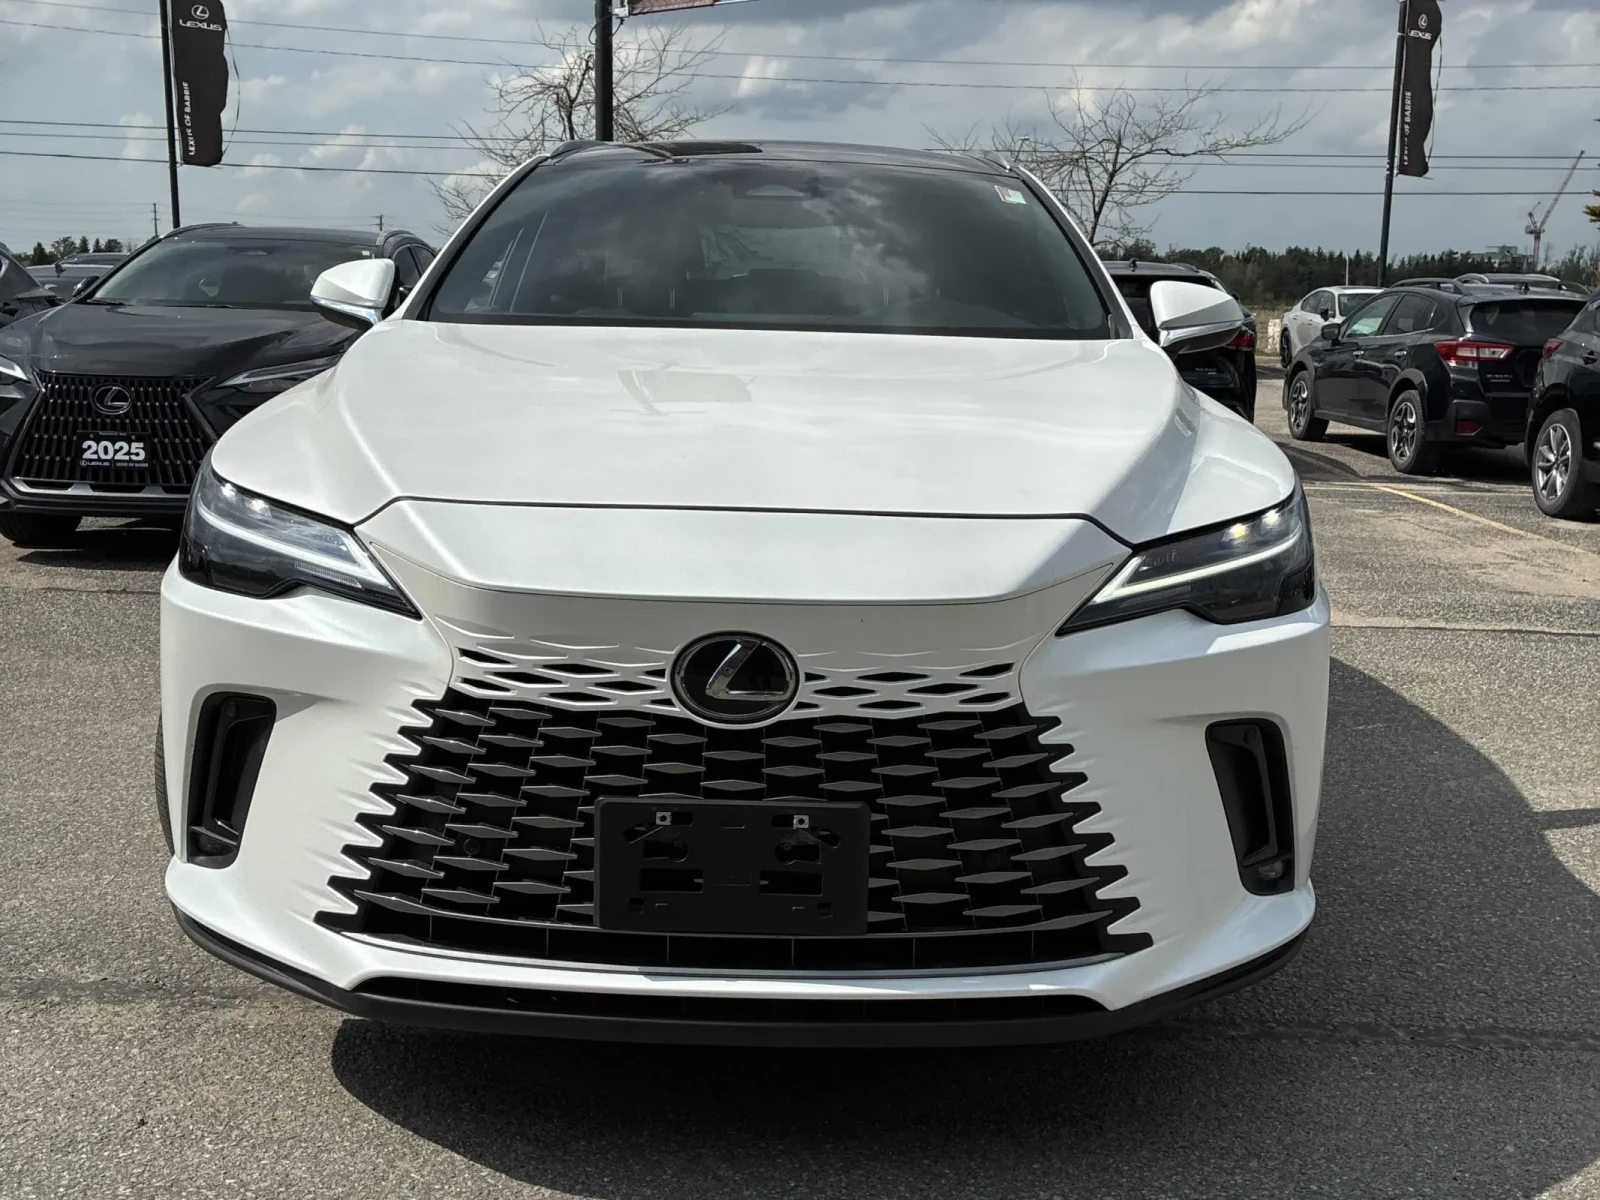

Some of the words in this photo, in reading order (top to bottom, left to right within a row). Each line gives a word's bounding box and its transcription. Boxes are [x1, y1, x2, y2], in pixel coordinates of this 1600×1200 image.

[179, 19, 222, 31] LEXUS
[1408, 29, 1432, 40] LEXUS
[182, 81, 191, 113] BARRIE
[184, 115, 191, 126] OF
[82, 440, 145, 461] 2025
